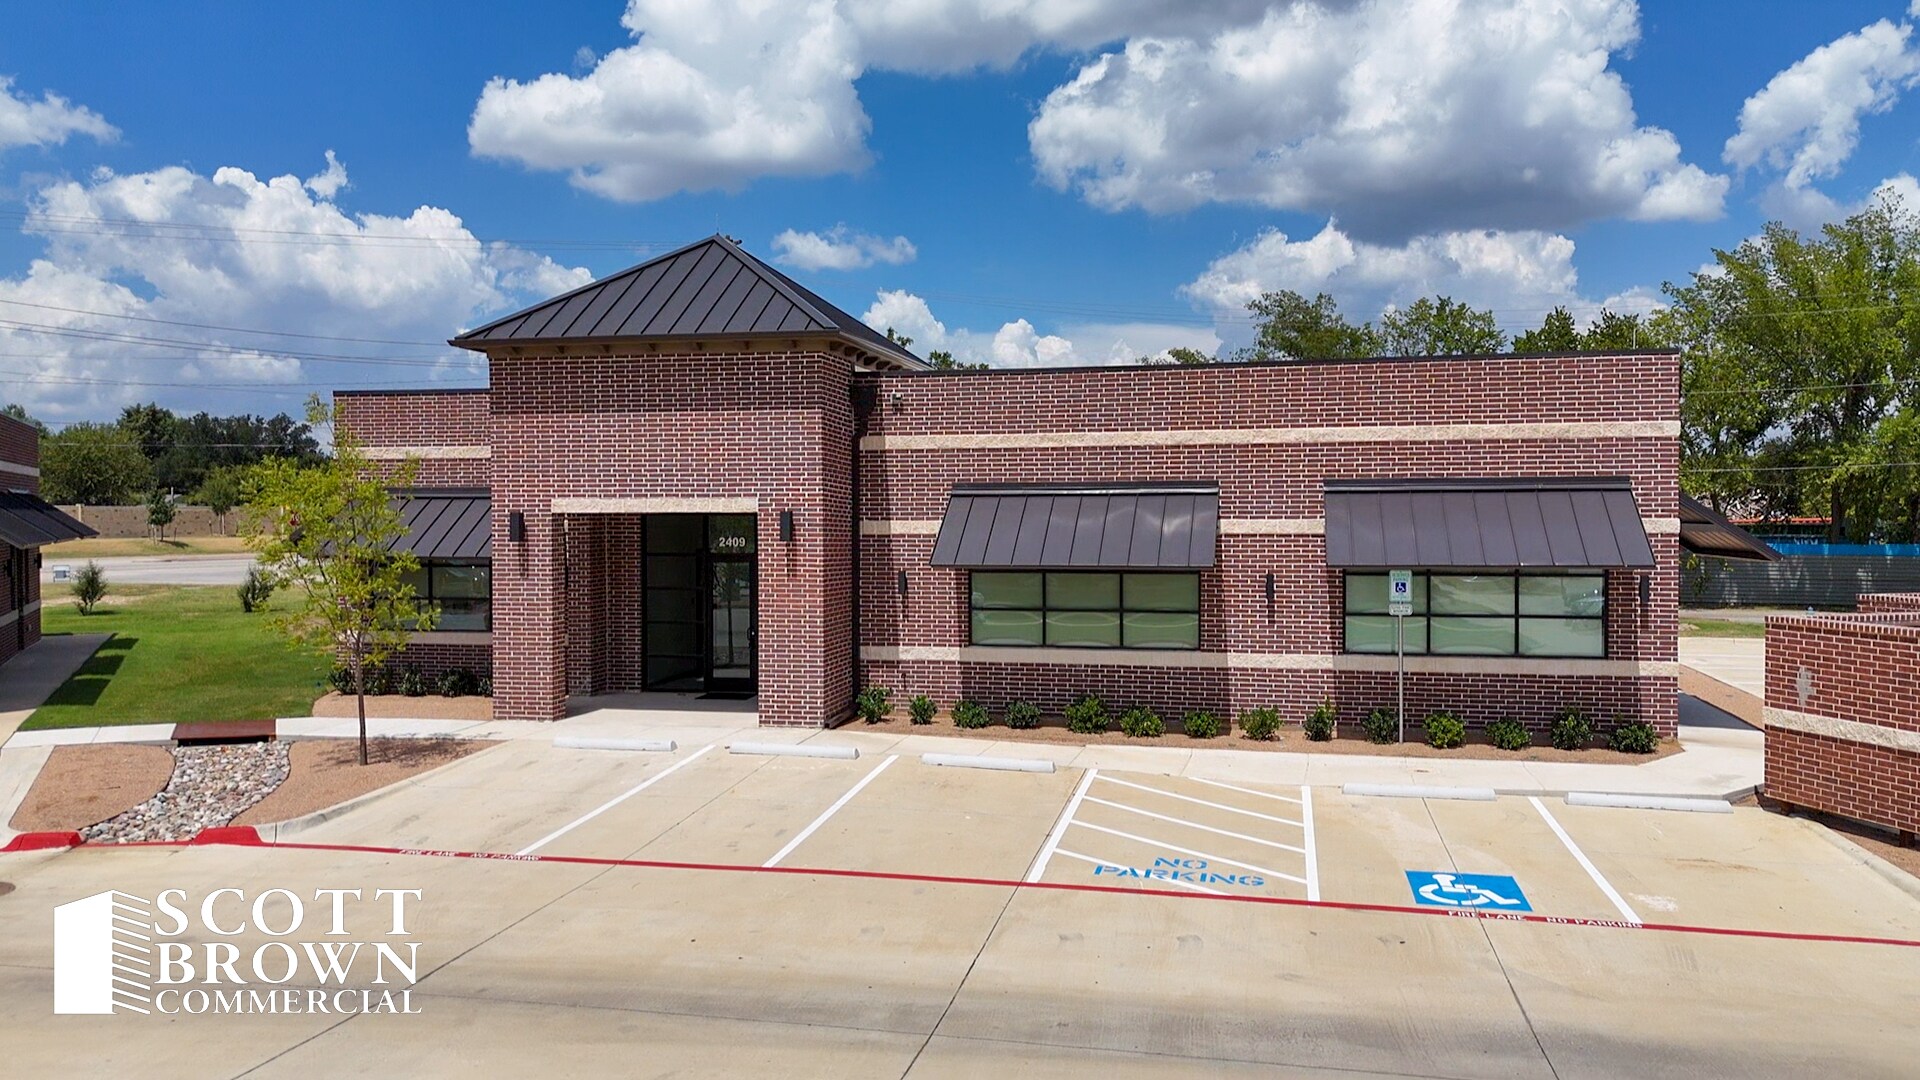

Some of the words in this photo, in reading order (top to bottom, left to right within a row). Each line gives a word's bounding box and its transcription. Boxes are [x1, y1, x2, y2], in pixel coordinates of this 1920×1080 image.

[718, 536, 746, 547] 2409
[1154, 857, 1208, 870] NO
[1093, 864, 1265, 887] PARKING
[1546, 916, 1568, 924] NO
[1574, 918, 1643, 929] PARKING
